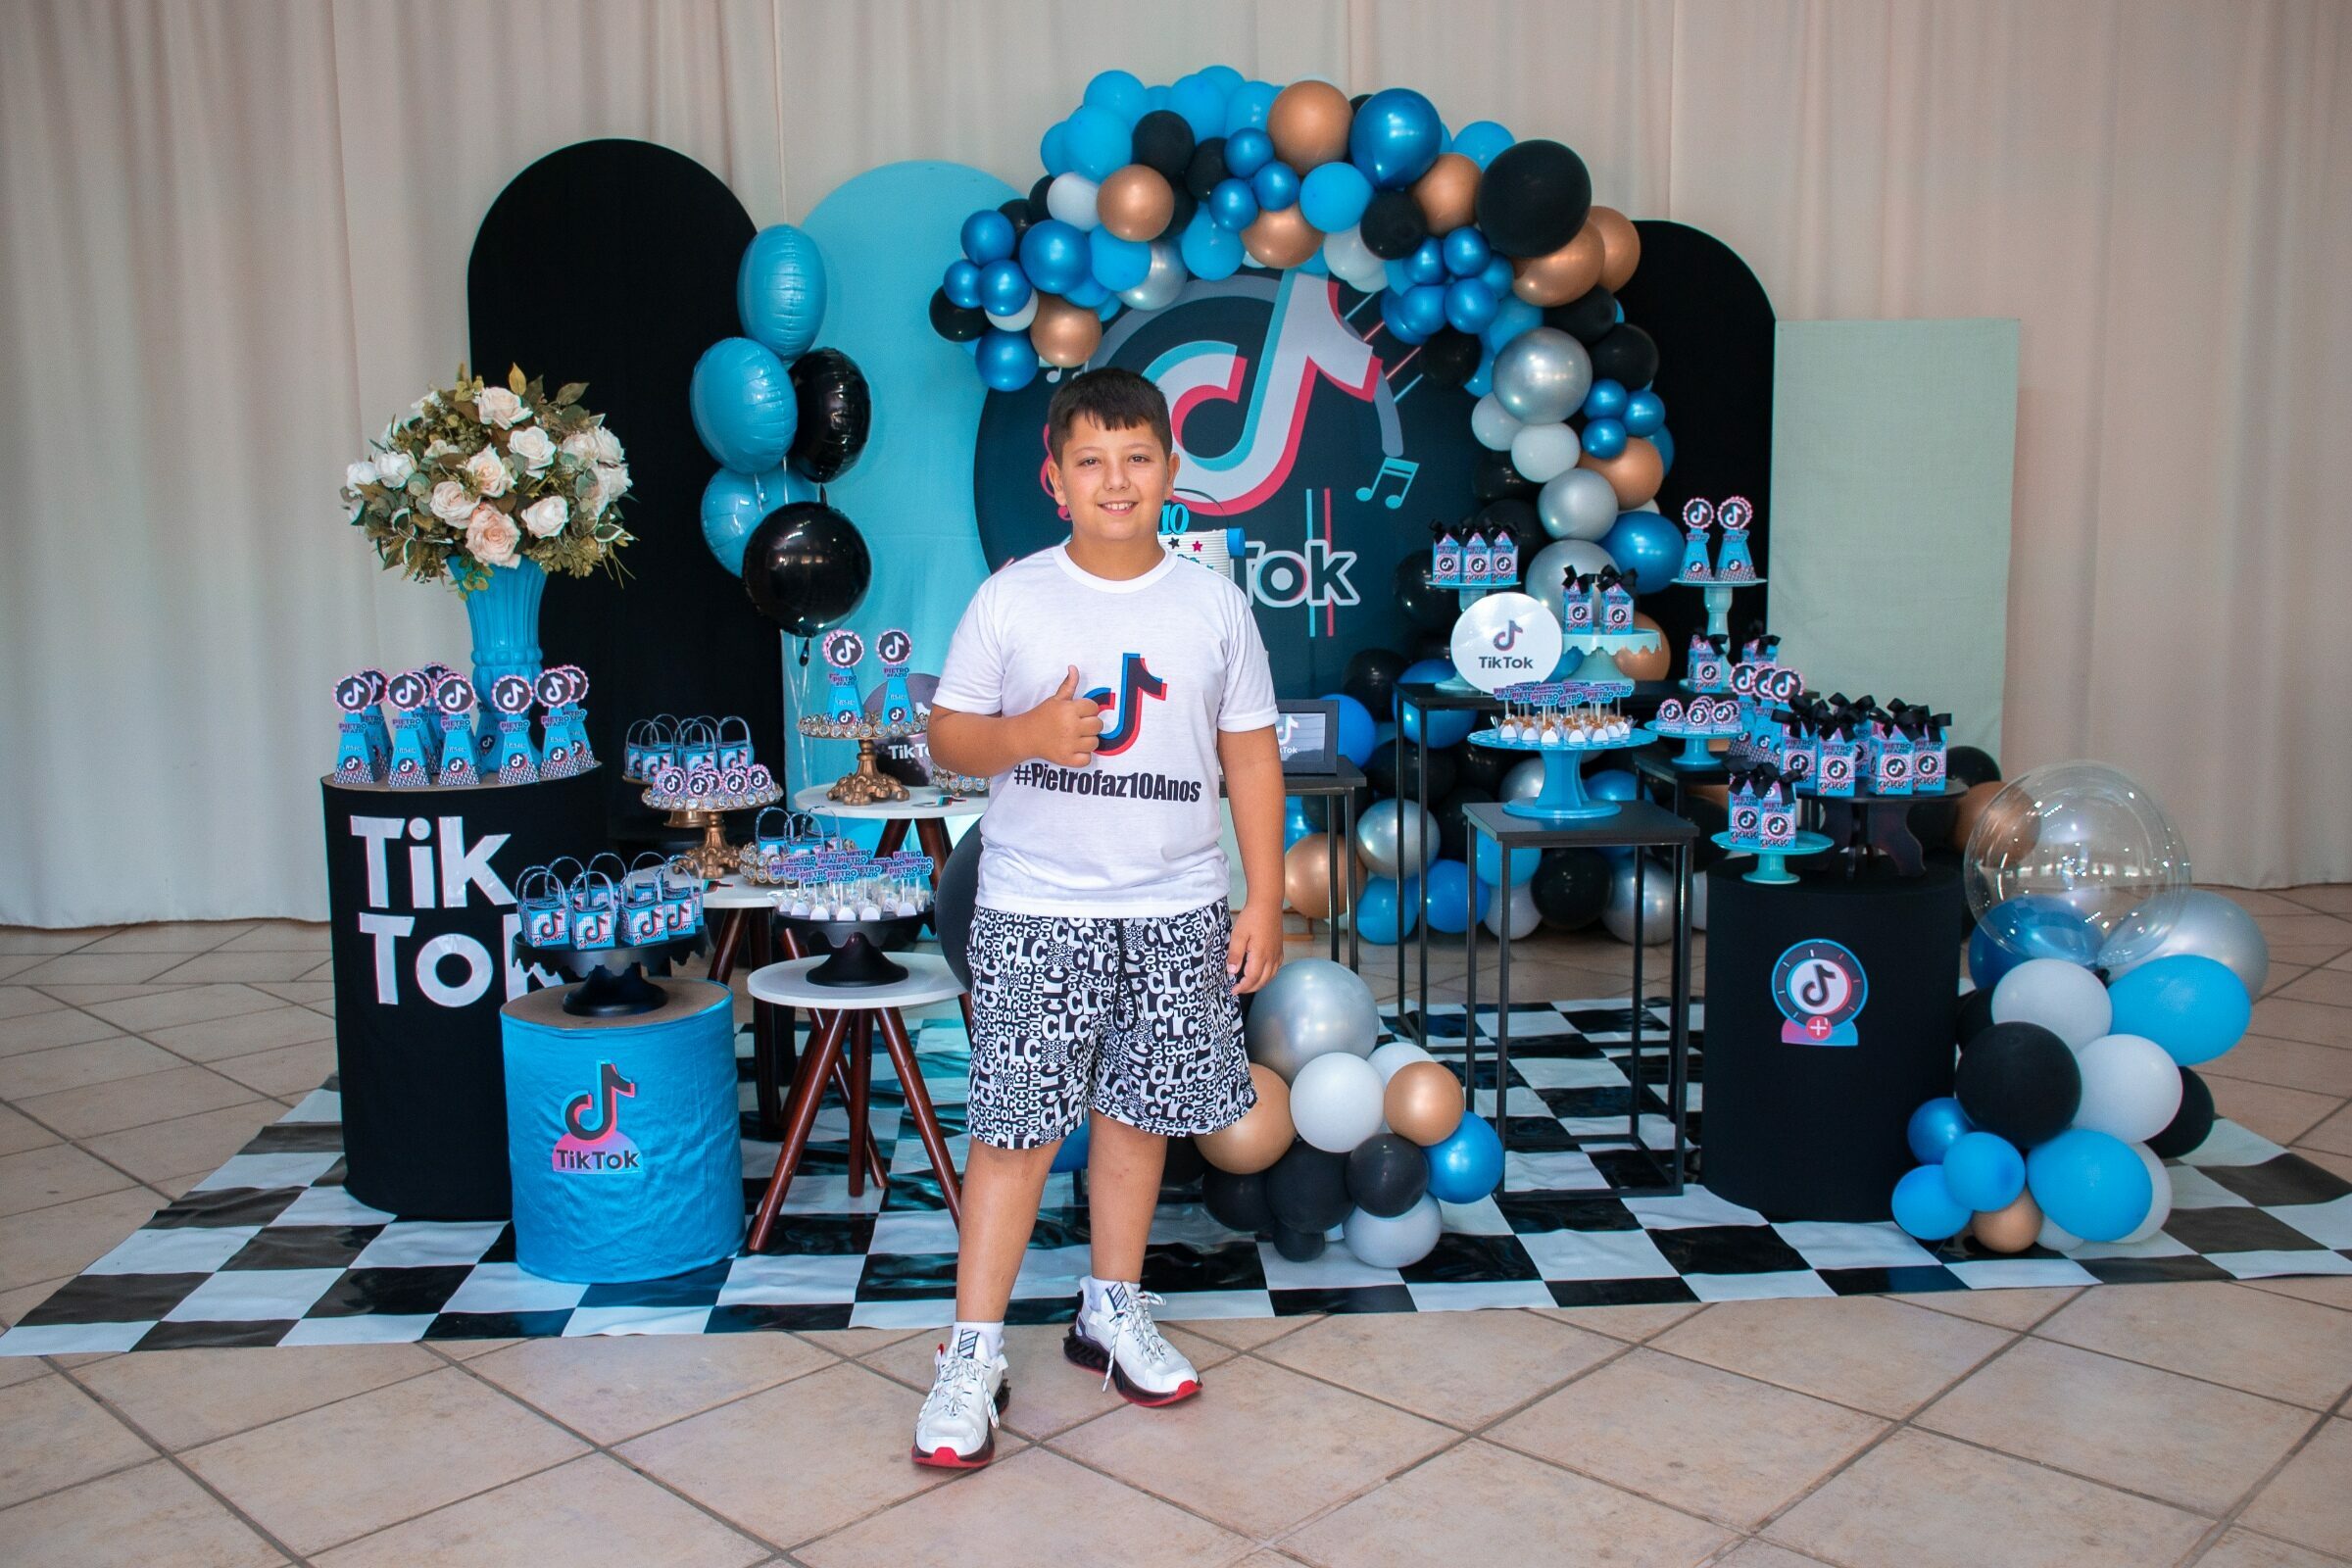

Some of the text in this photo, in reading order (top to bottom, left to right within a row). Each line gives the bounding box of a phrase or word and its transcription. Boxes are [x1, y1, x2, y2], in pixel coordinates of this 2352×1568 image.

[1159, 502, 1190, 536] 10
[1478, 656, 1534, 669] TikTok
[1014, 762, 1202, 804] #Pietrofaz10Anos
[350, 814, 519, 909] Tik
[894, 850, 922, 858] PIETRO
[828, 869, 858, 878] PIETRO
[1002, 936, 1049, 965] CLC
[1148, 969, 1196, 994] CLC
[1043, 1014, 1092, 1041] CLC
[1152, 1016, 1199, 1042] CLC
[996, 1036, 1042, 1063] CLC
[1150, 1061, 1198, 1085] CLC
[1145, 1102, 1195, 1122] CLC
[556, 1150, 640, 1170] TikTok
